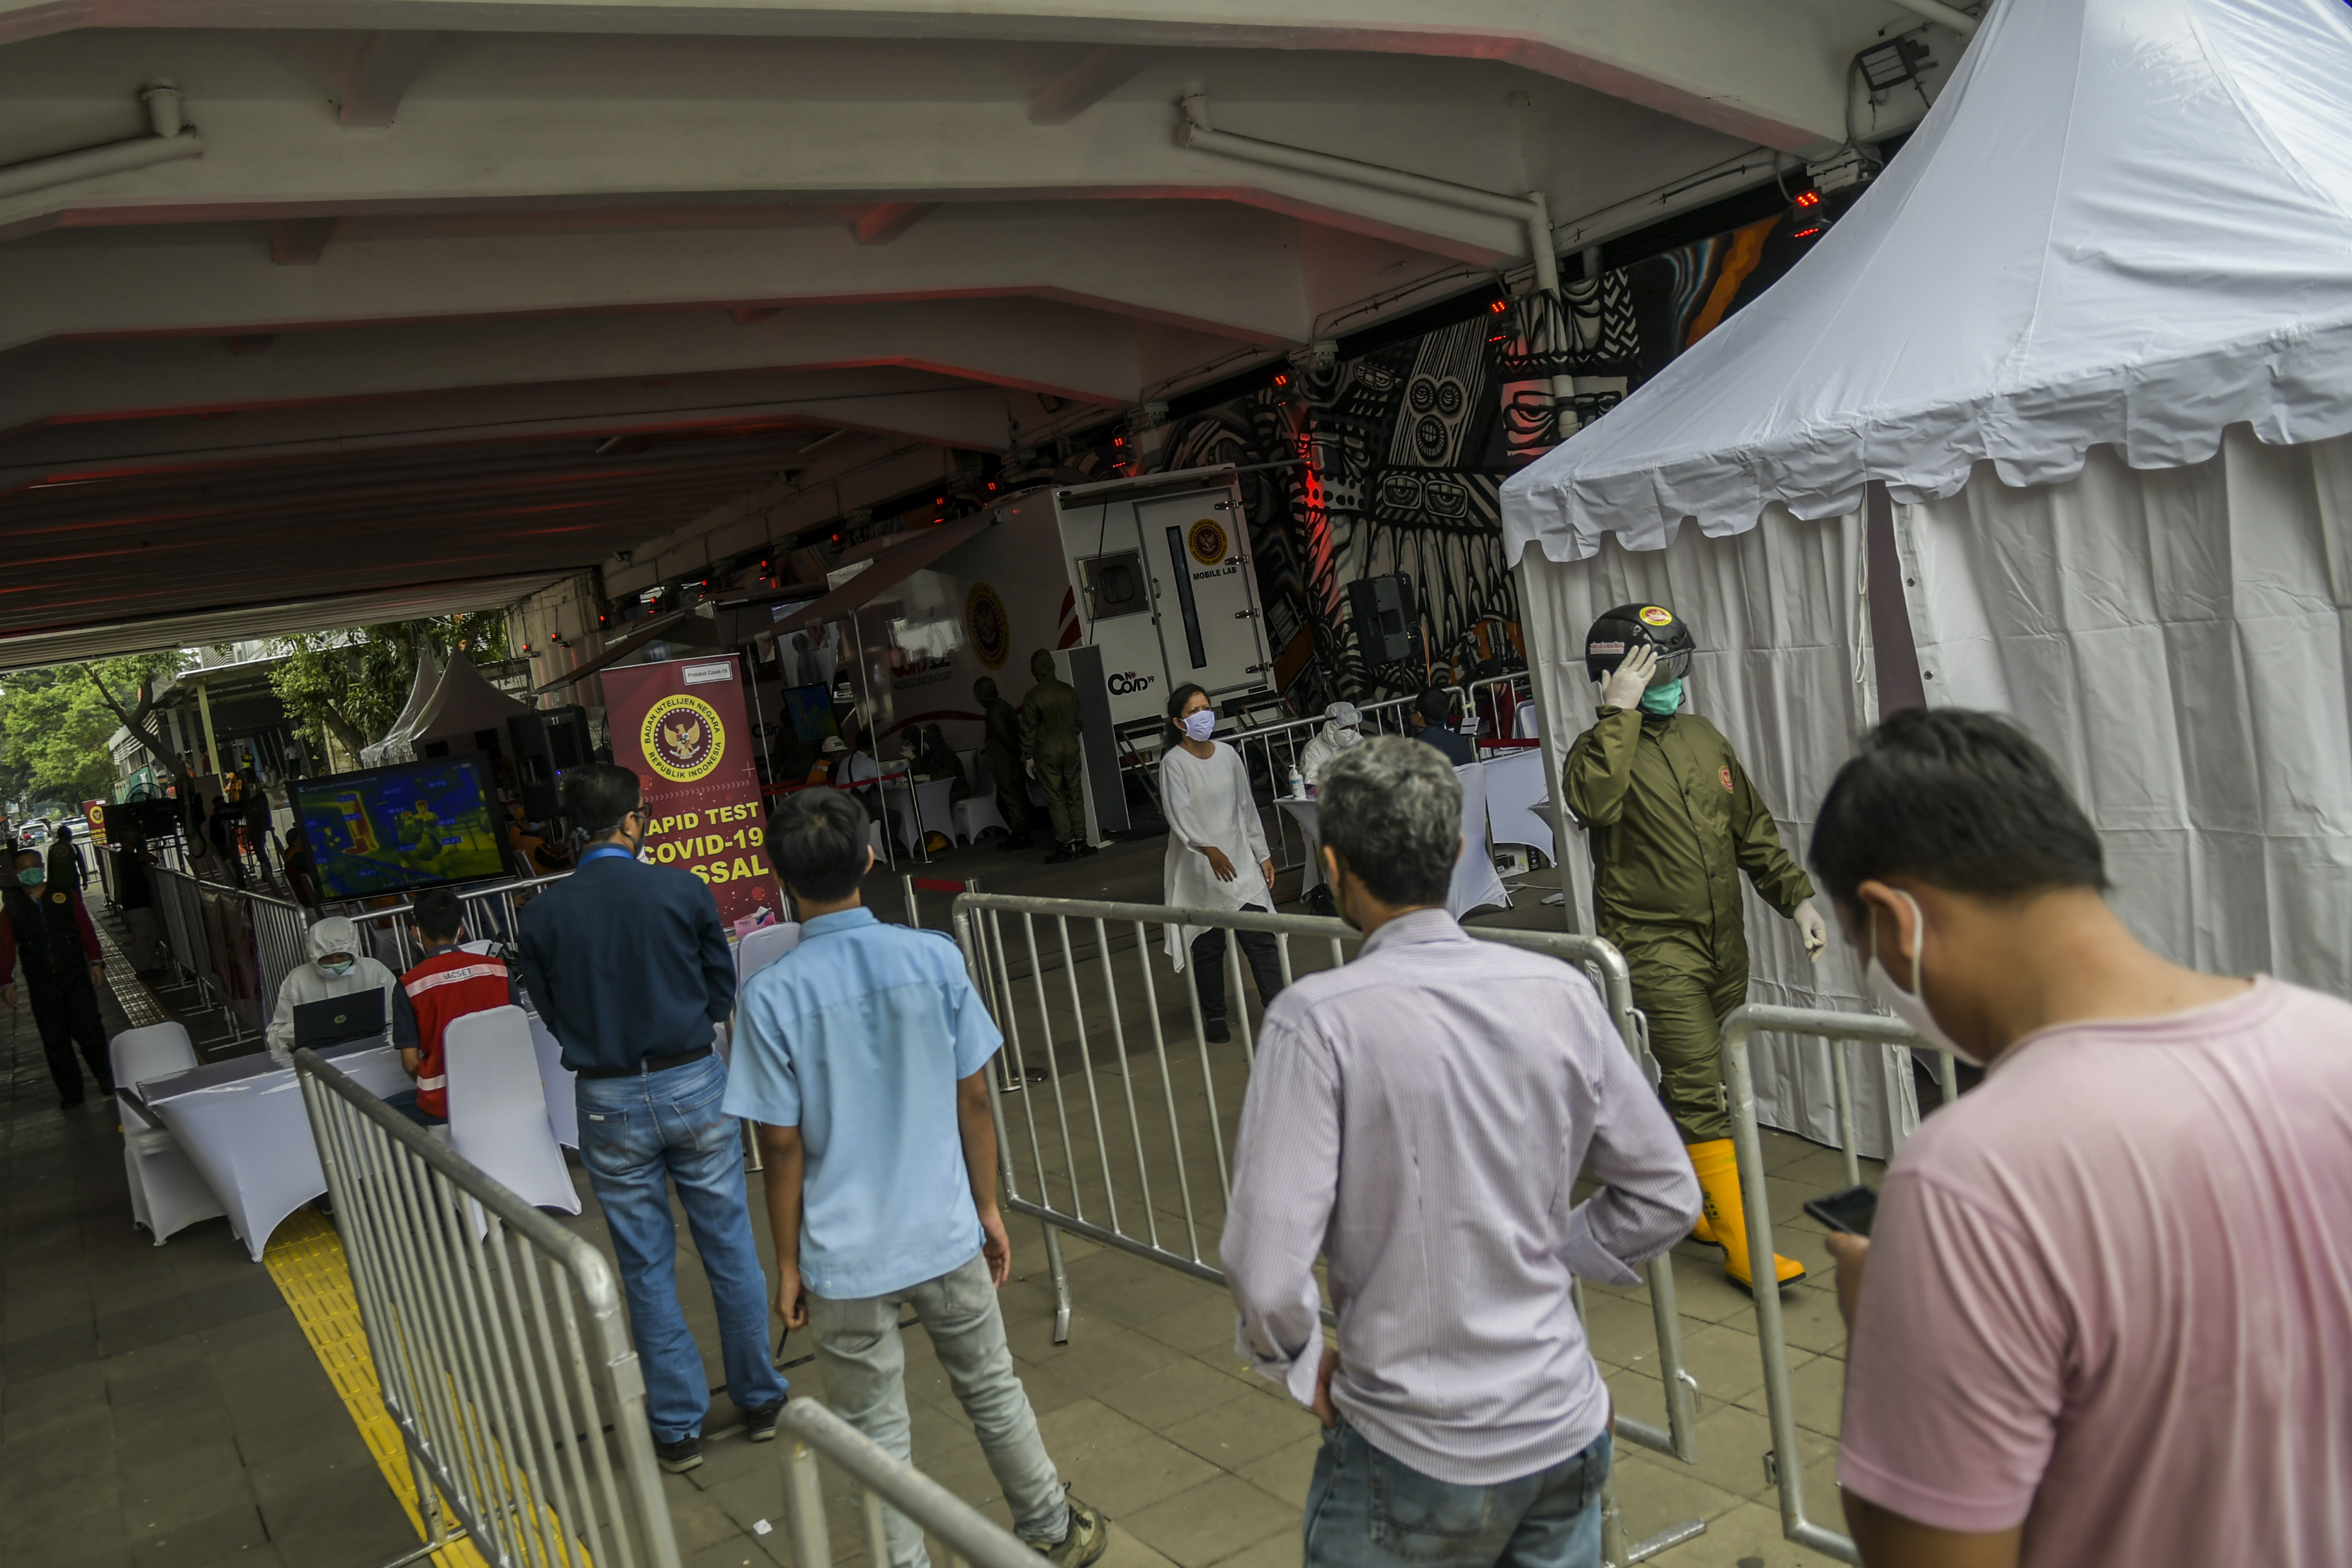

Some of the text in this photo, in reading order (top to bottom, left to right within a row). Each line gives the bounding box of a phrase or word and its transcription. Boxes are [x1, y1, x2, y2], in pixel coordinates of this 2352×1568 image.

[1193, 567, 1237, 580] MOBILE LAB
[894, 670, 953, 690] MOBILE LABORATORY
[551, 716, 559, 726] 11
[644, 698, 720, 744] BADAN INTELIJEN NEGARA
[648, 742, 721, 778] REPUBLIK INDONESIA
[645, 801, 759, 837] APID TEST
[644, 827, 764, 865] COVID-19
[690, 854, 769, 884] SSAL
